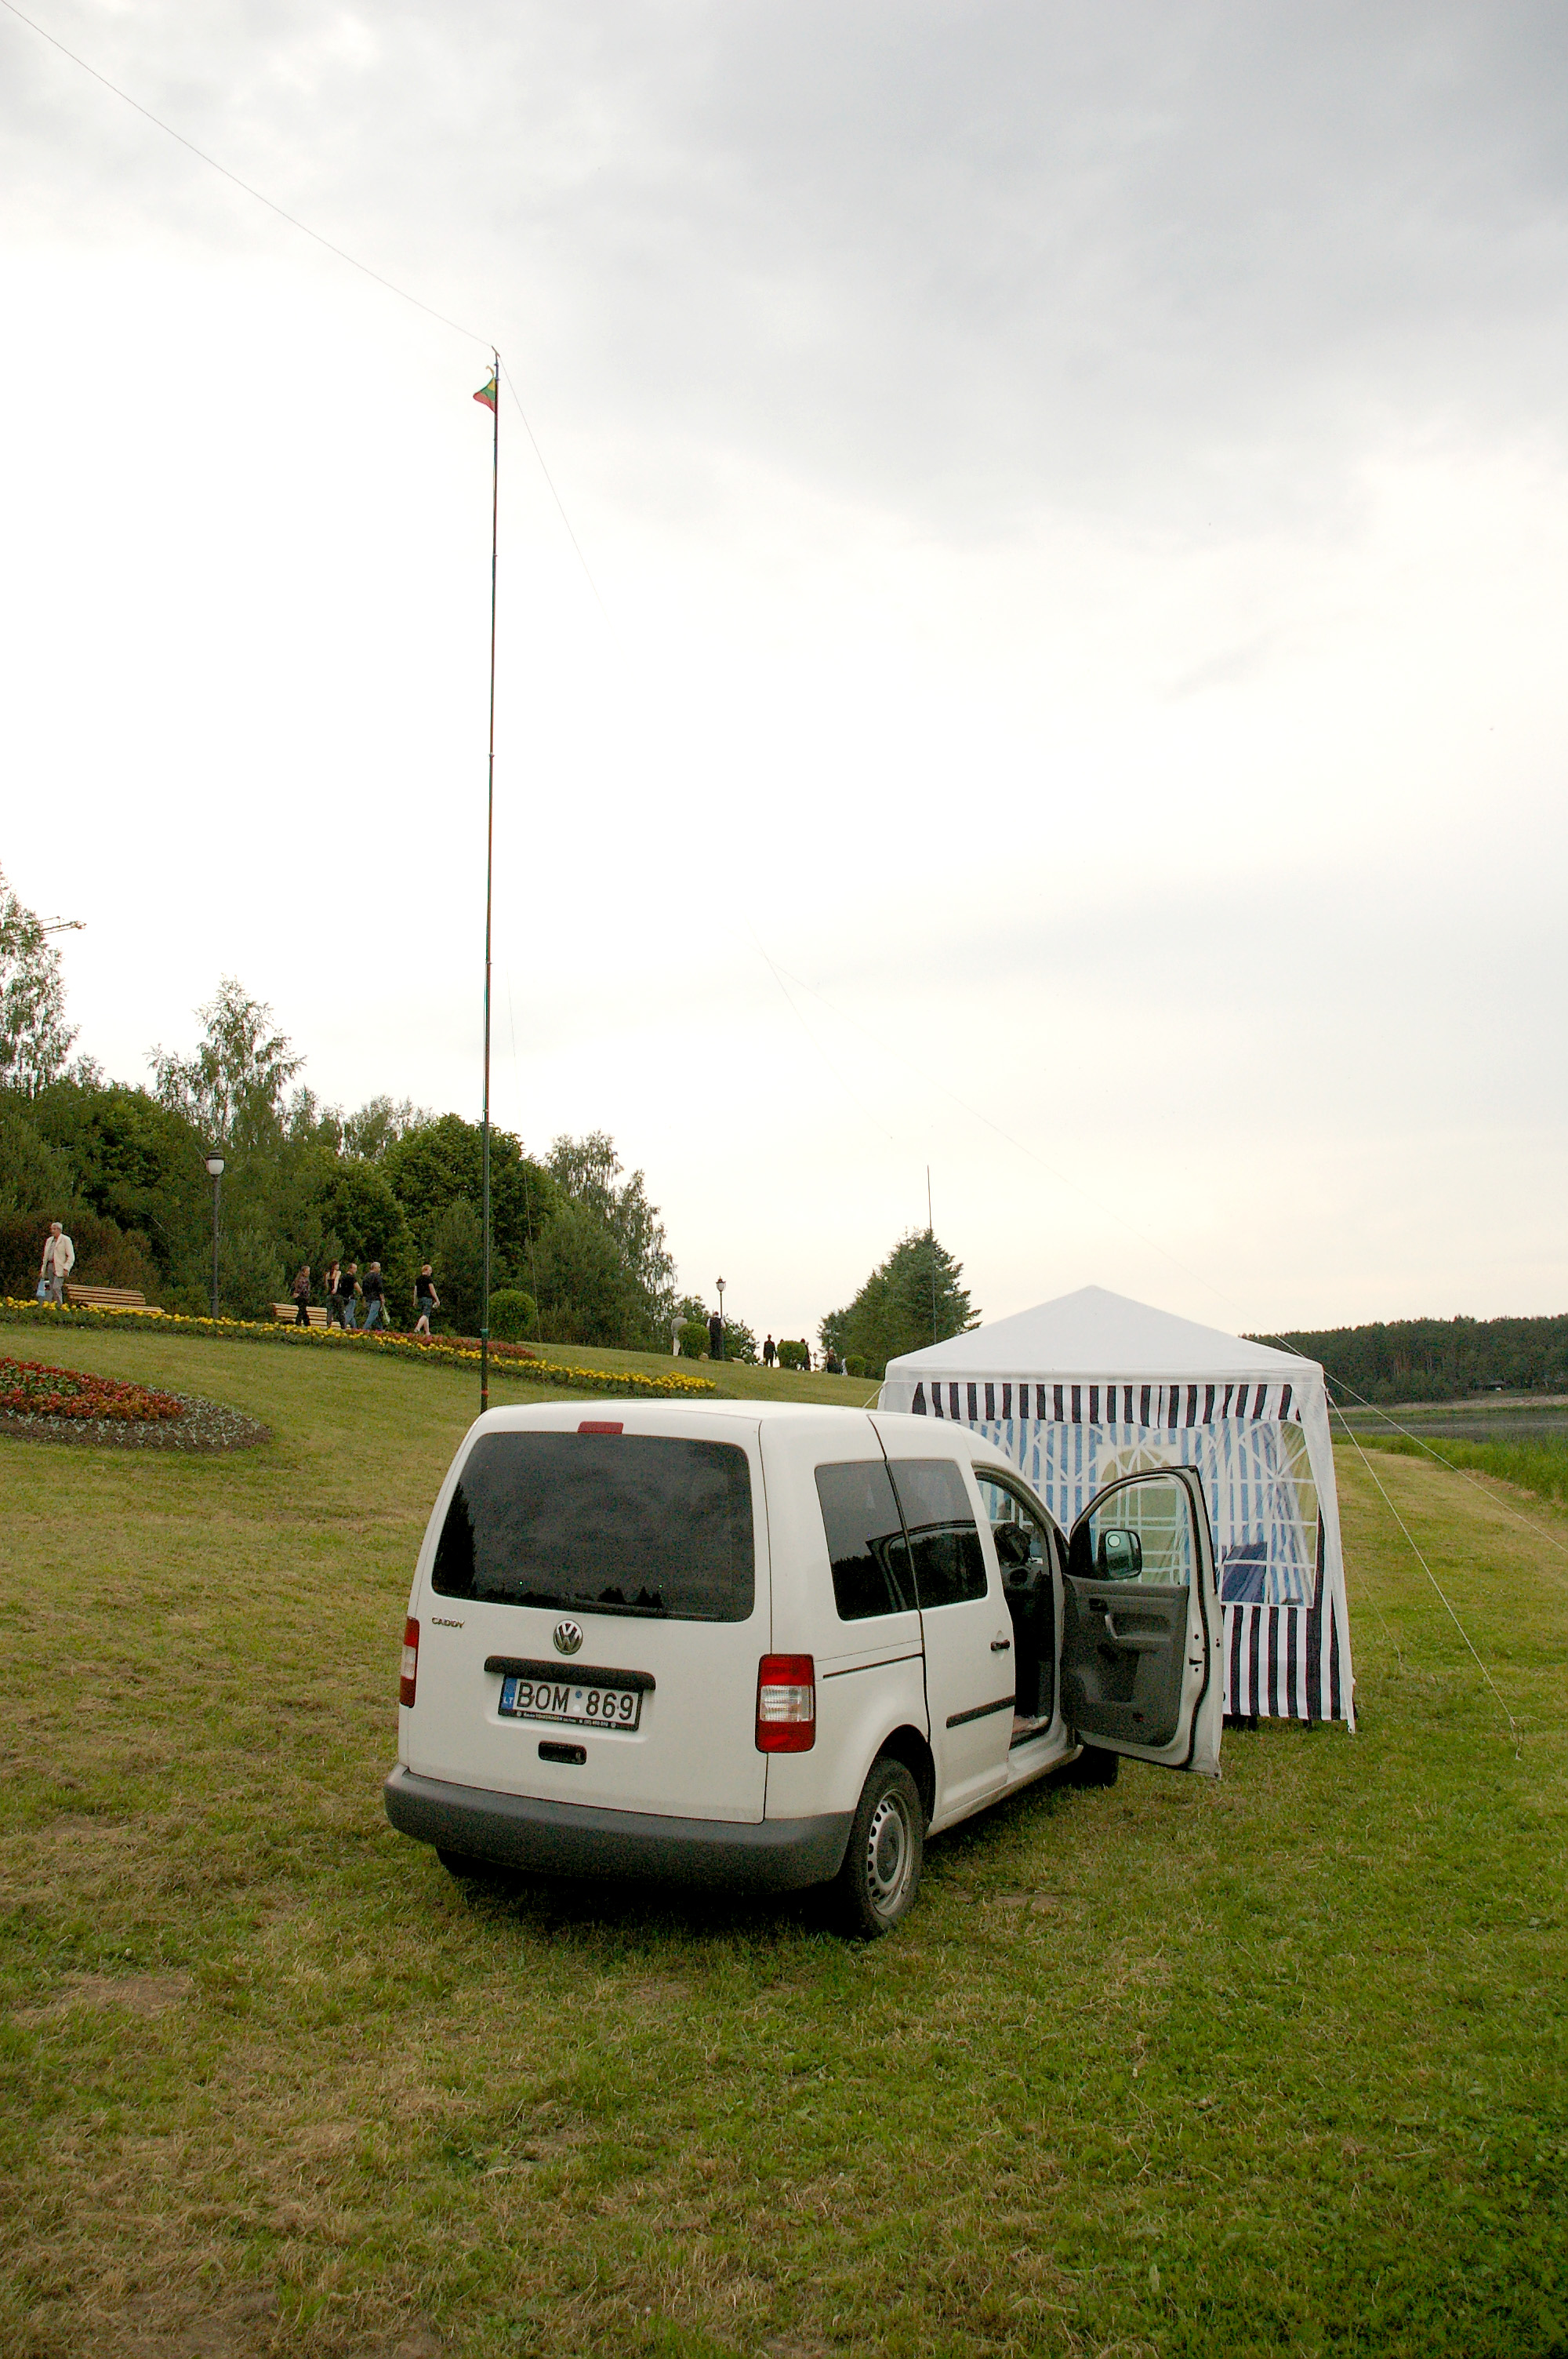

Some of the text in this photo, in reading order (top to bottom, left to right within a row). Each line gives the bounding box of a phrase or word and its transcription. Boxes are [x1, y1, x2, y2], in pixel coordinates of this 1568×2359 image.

[431, 1616, 465, 1628] CADDY
[503, 1696, 514, 1705] LT
[516, 1681, 571, 1713] BOM
[586, 1690, 634, 1721] 869
